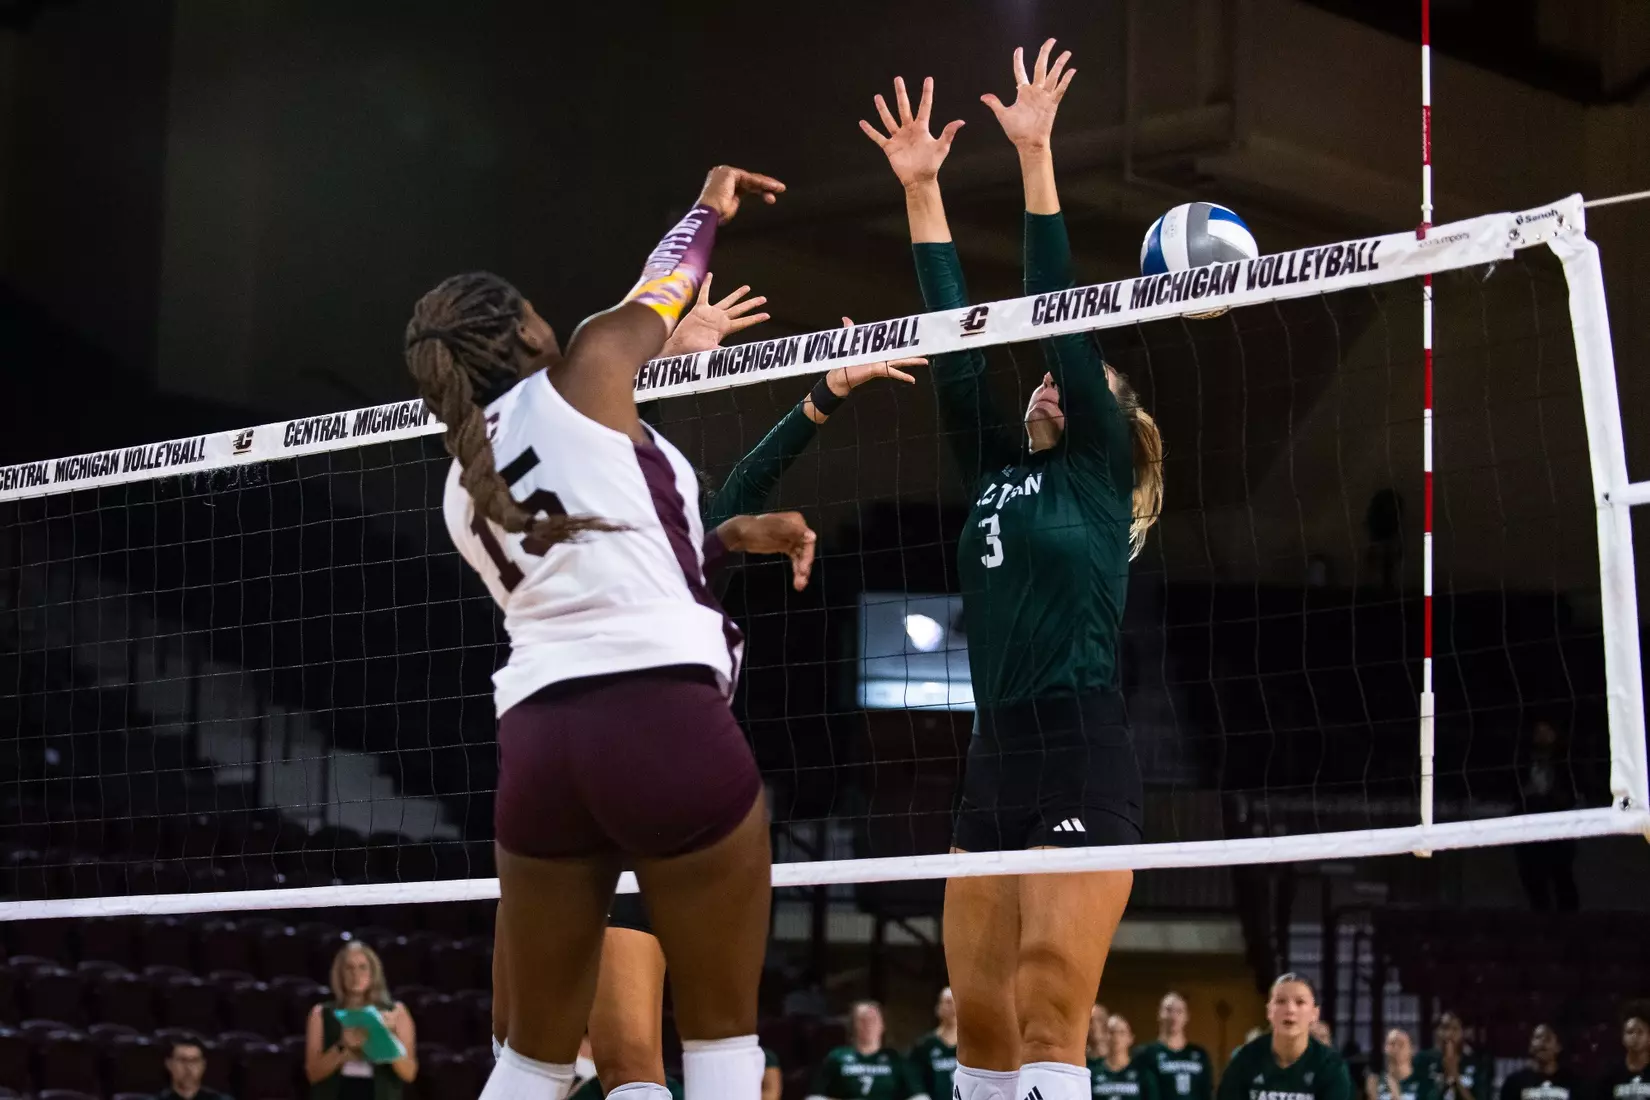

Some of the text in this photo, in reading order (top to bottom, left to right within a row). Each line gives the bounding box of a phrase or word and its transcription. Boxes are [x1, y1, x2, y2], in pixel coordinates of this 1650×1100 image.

[1031, 240, 1381, 326] CENTRAL MICHIGAN VOLLEYBALL
[634, 317, 919, 391] ENTRAL MICHIGAN VOLLEYBALL
[283, 401, 430, 447] CENTRAL MICHIGAN
[54, 452, 121, 483] MICHIGAN
[122, 437, 206, 473] VOLLEYBALL
[977, 513, 1004, 569] 3
